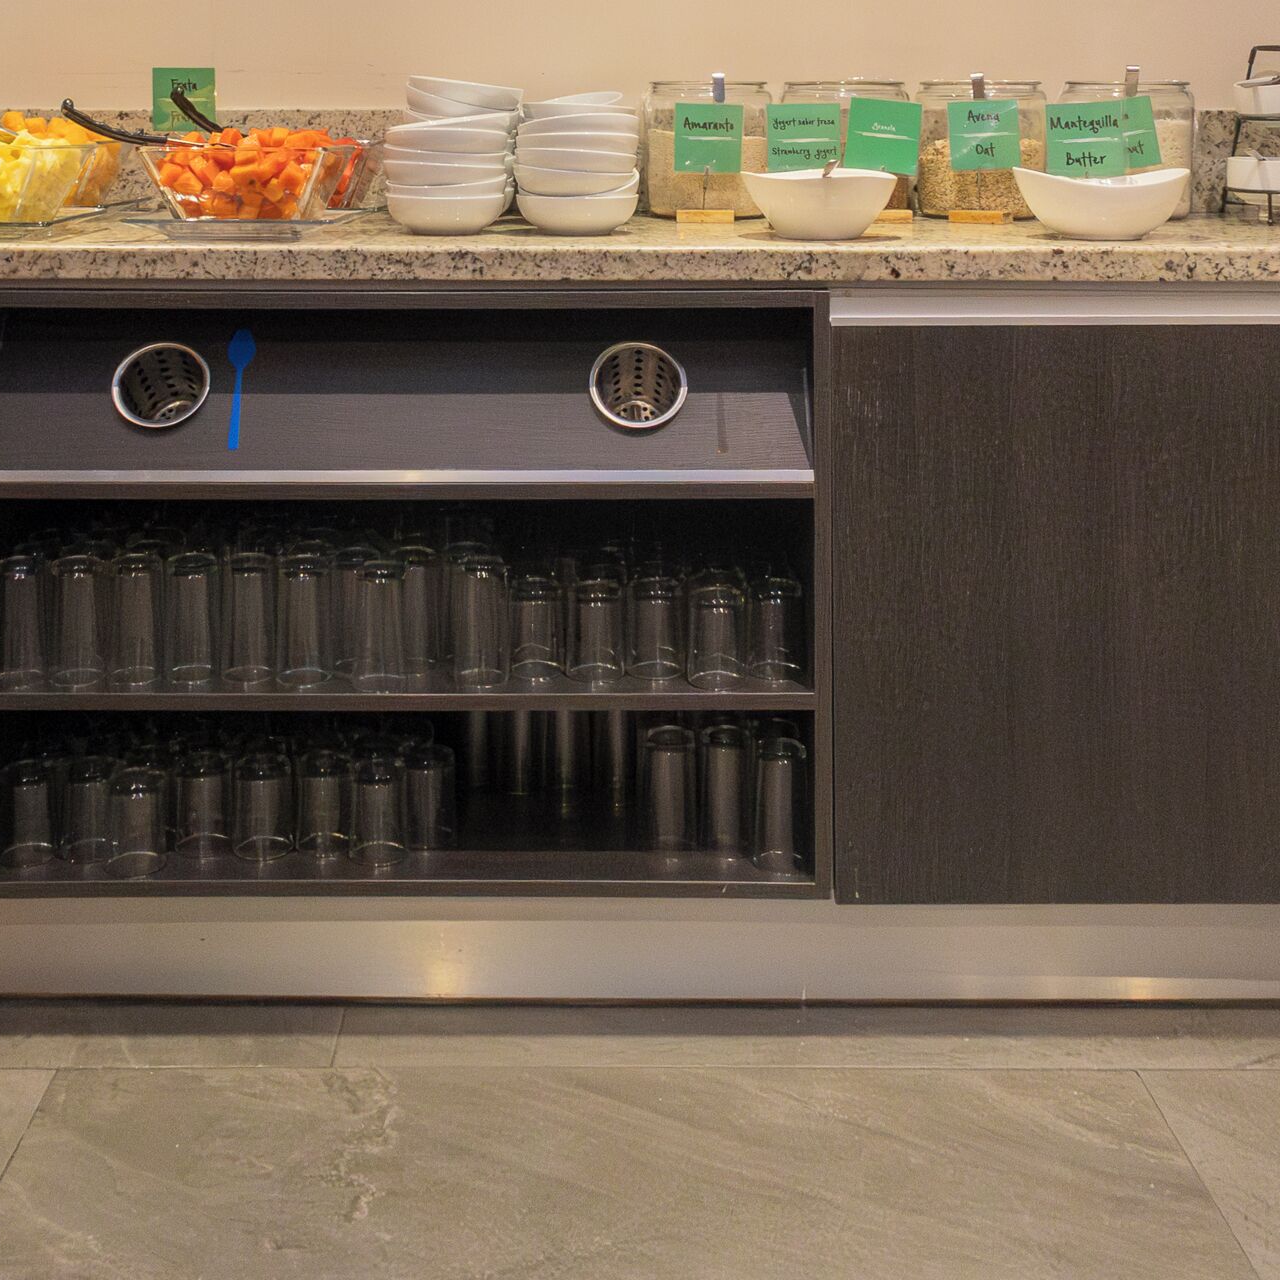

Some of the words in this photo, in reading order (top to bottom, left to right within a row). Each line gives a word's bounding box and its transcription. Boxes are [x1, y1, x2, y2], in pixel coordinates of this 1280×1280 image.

[683, 116, 735, 132] Amaranto
[967, 109, 1001, 123] Avena
[1049, 114, 1120, 134] Mantequilla
[975, 142, 996, 158] Oat
[1065, 151, 1107, 168] Butter
